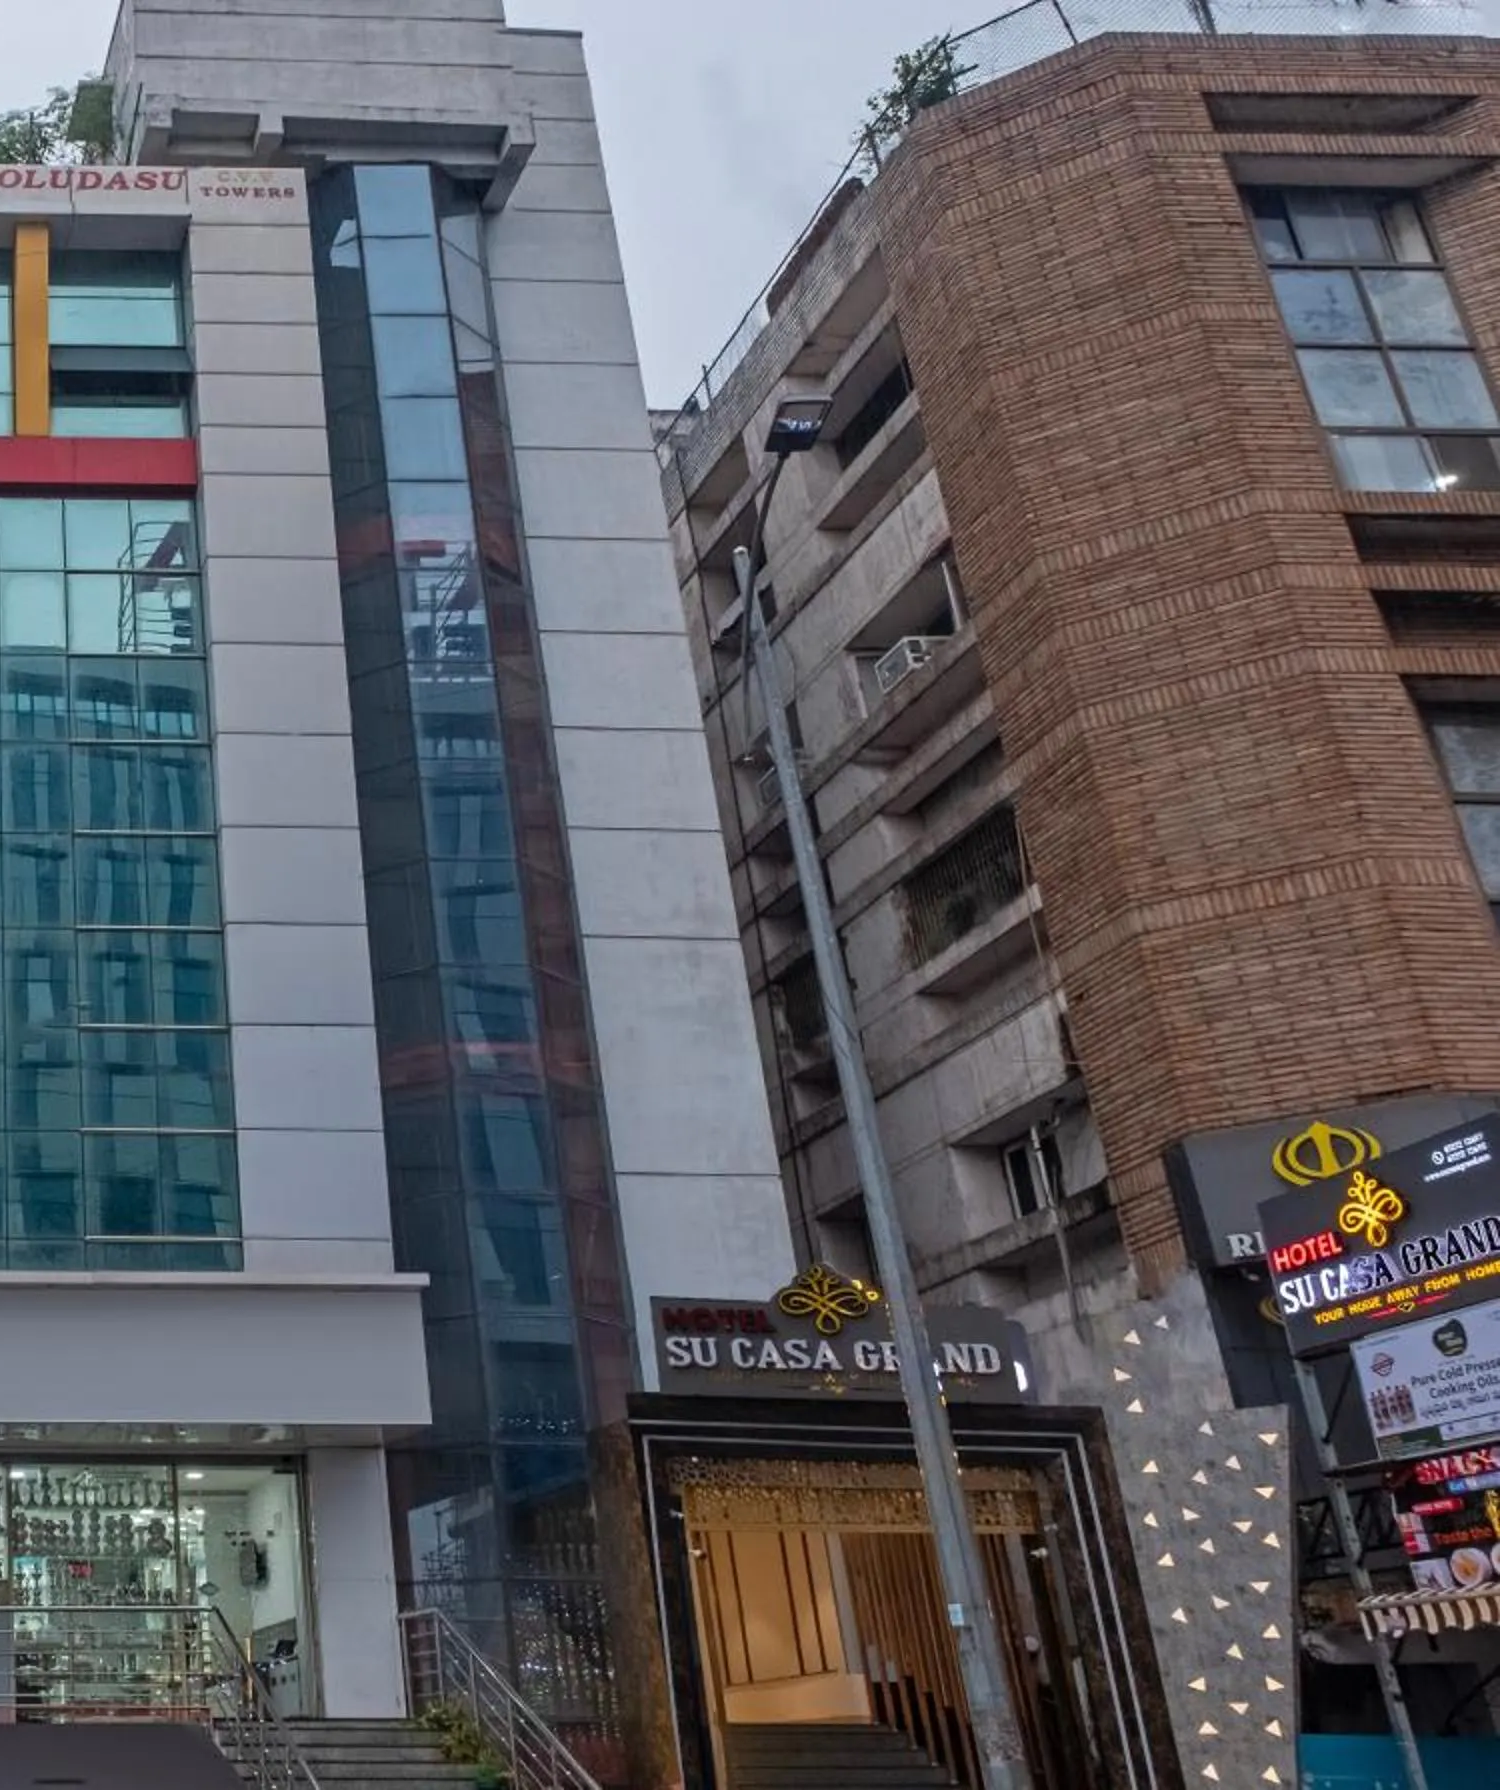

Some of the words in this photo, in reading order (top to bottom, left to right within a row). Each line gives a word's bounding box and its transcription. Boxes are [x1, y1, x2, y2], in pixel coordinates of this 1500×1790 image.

[199, 186, 295, 199] TOWERS
[1273, 1231, 1343, 1273] HOTEL
[1279, 1273, 1318, 1315] SU
[1320, 1253, 1394, 1301] CASA
[1401, 1216, 1500, 1276] GRAND
[1314, 1307, 1345, 1325] YOUR
[1386, 1285, 1420, 1304] AWAY
[1424, 1272, 1461, 1293] FROM
[1465, 1259, 1500, 1281] HOME
[665, 1336, 718, 1368] SU
[730, 1337, 843, 1372] CASA
[853, 1340, 1002, 1375] GRND
[1429, 1380, 1477, 1399] Cooking
